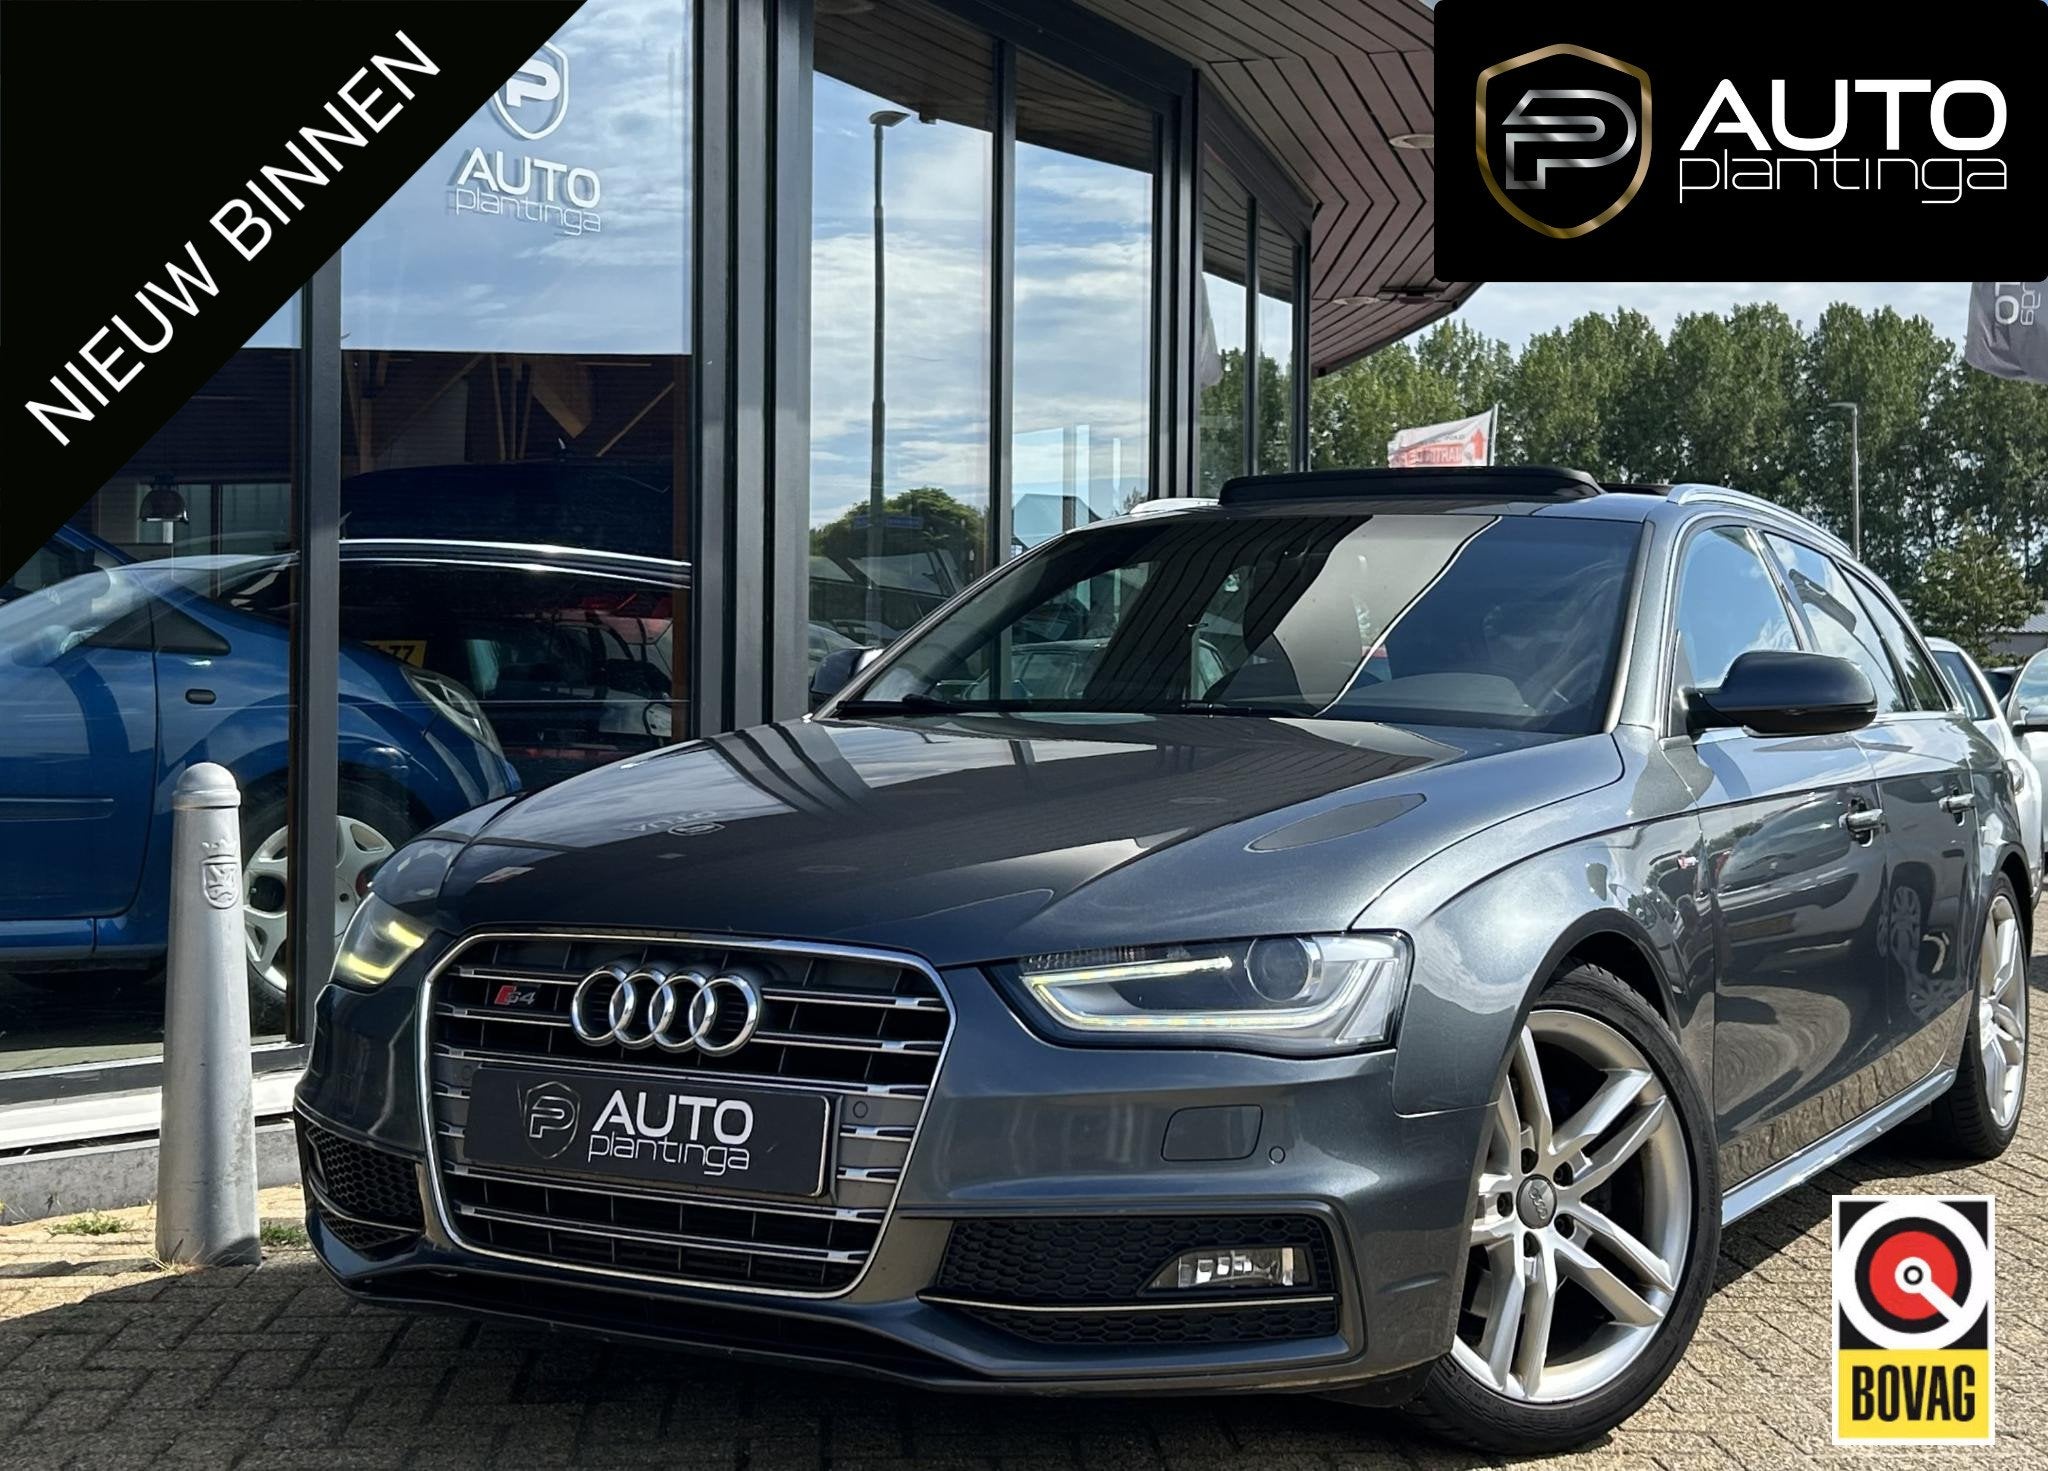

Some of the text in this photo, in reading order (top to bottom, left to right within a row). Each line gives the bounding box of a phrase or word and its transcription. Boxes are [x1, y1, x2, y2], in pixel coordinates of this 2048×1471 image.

[457, 147, 601, 209] AUTO
[456, 187, 601, 236] plantinga
[592, 1089, 754, 1145] AUTO
[587, 1131, 750, 1176] plantinga
